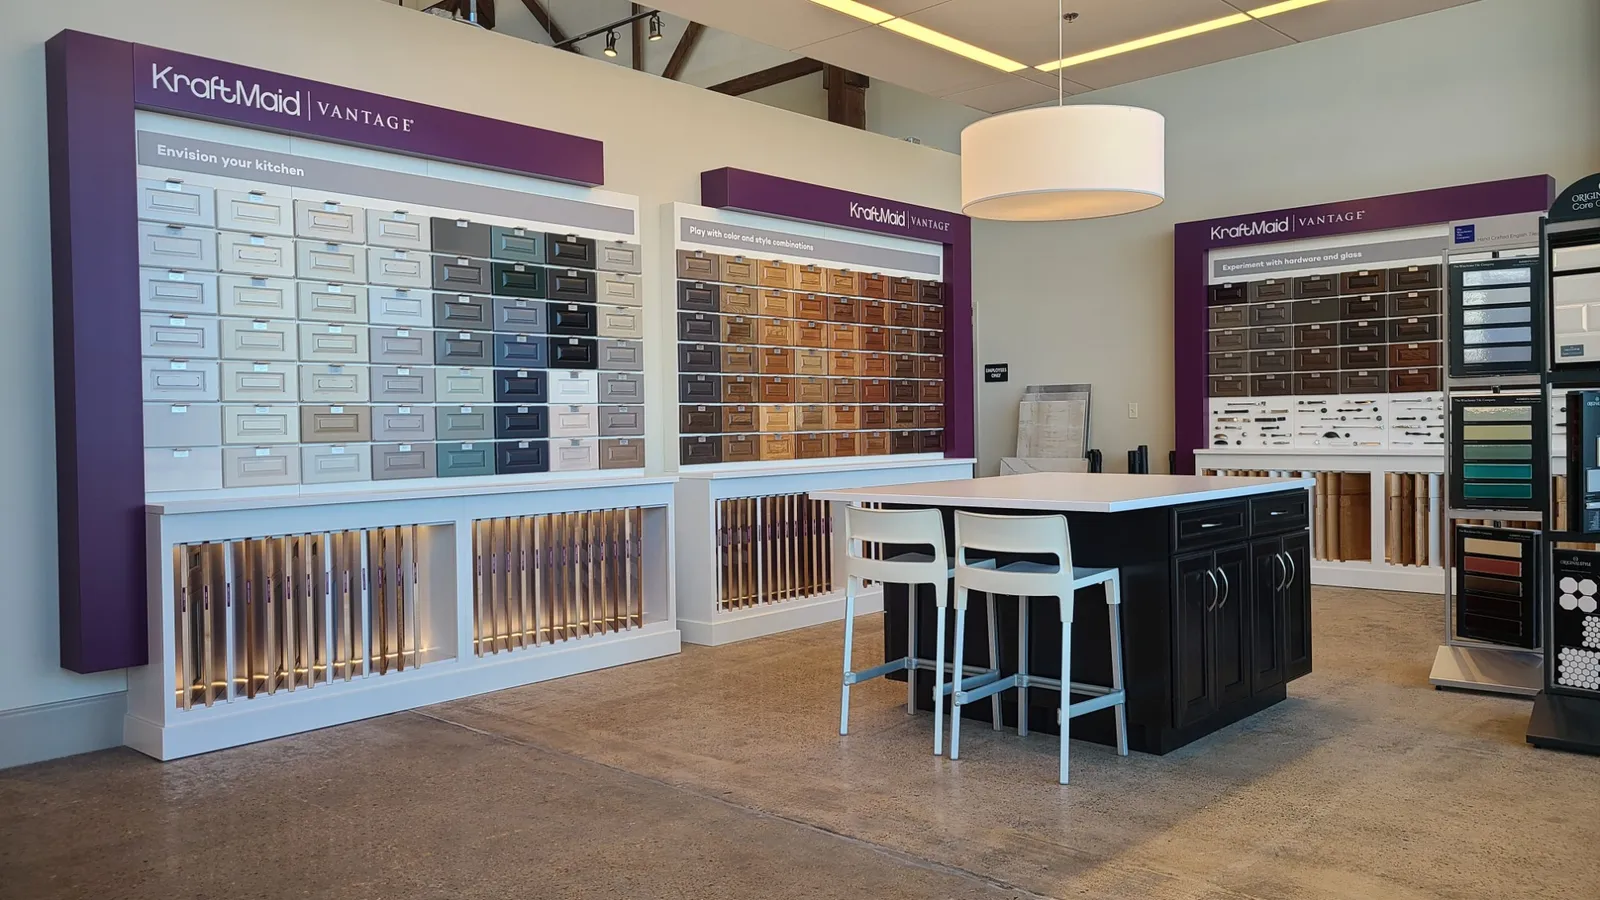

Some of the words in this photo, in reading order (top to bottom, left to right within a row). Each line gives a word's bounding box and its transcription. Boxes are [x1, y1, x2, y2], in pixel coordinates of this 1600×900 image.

[152, 63, 301, 117] KraftMaid
[157, 144, 218, 164] Envision
[221, 156, 252, 171] your
[255, 159, 305, 177] kitchen
[850, 201, 906, 227] KraftMaid
[1572, 202, 1593, 210] Core
[689, 226, 706, 237] Play
[707, 228, 722, 239] with
[723, 230, 740, 241] color
[741, 232, 754, 243] and
[755, 234, 772, 246] style
[772, 237, 814, 251] combinations
[1210, 216, 1289, 240] KraftMaid
[1222, 260, 1264, 272] Experiment
[1266, 257, 1284, 267] with
[1284, 254, 1321, 265] hardware
[1323, 252, 1339, 262] and
[1340, 251, 1362, 261] glass
